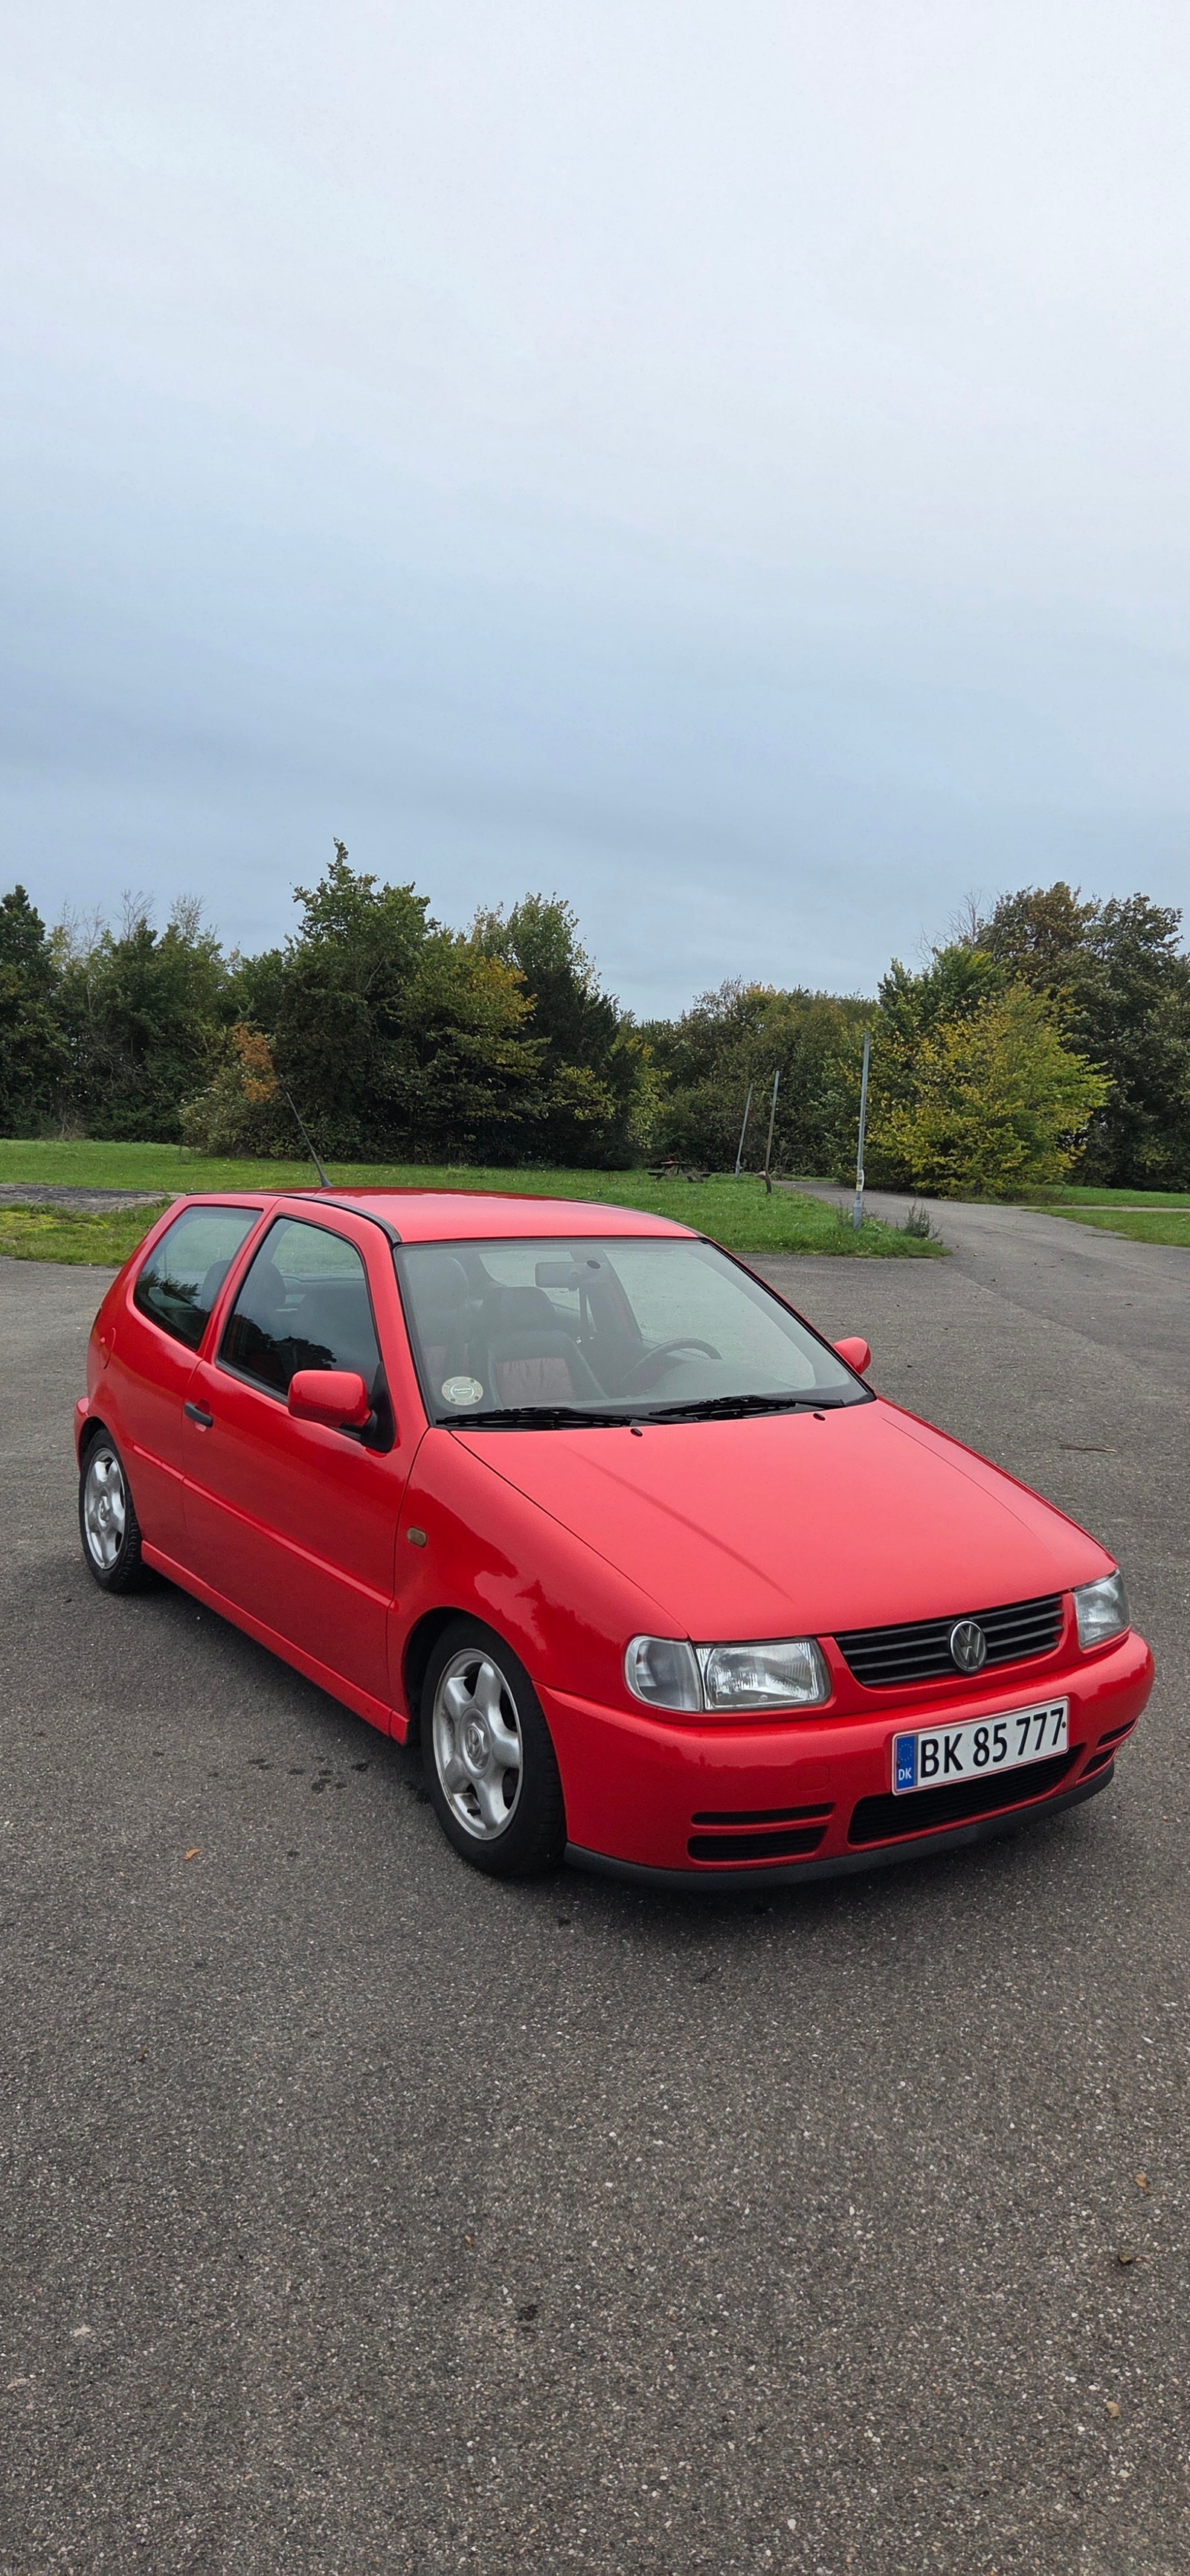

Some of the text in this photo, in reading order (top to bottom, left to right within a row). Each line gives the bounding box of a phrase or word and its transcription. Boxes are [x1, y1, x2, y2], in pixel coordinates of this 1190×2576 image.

[951, 1621, 985, 1671] VW
[920, 1707, 1064, 1778] BK 85 777
[898, 1767, 912, 1781] DK
